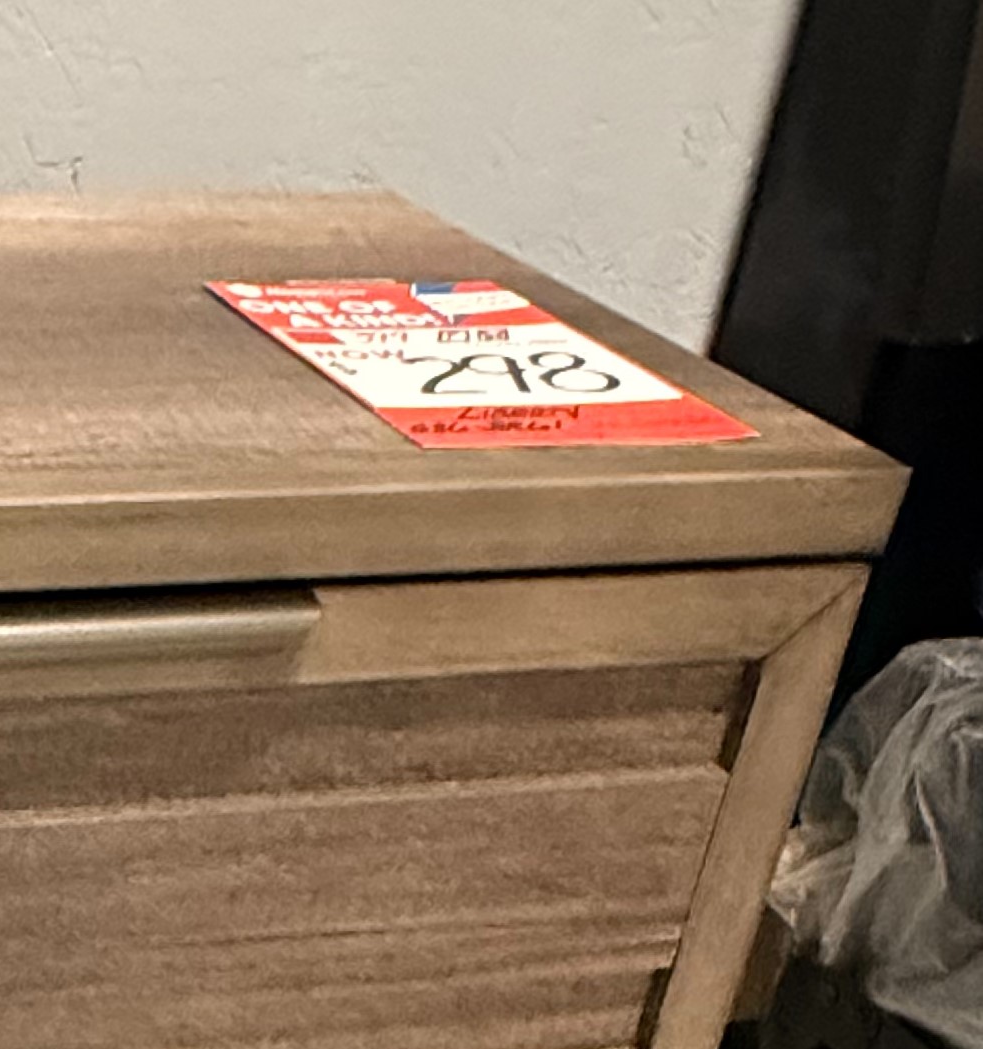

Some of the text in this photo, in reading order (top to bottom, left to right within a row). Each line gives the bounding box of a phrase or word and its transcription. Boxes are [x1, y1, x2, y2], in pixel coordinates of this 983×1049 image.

[239, 299, 396, 314] ONE OF
[290, 314, 321, 327] A
[401, 351, 620, 393] 298
